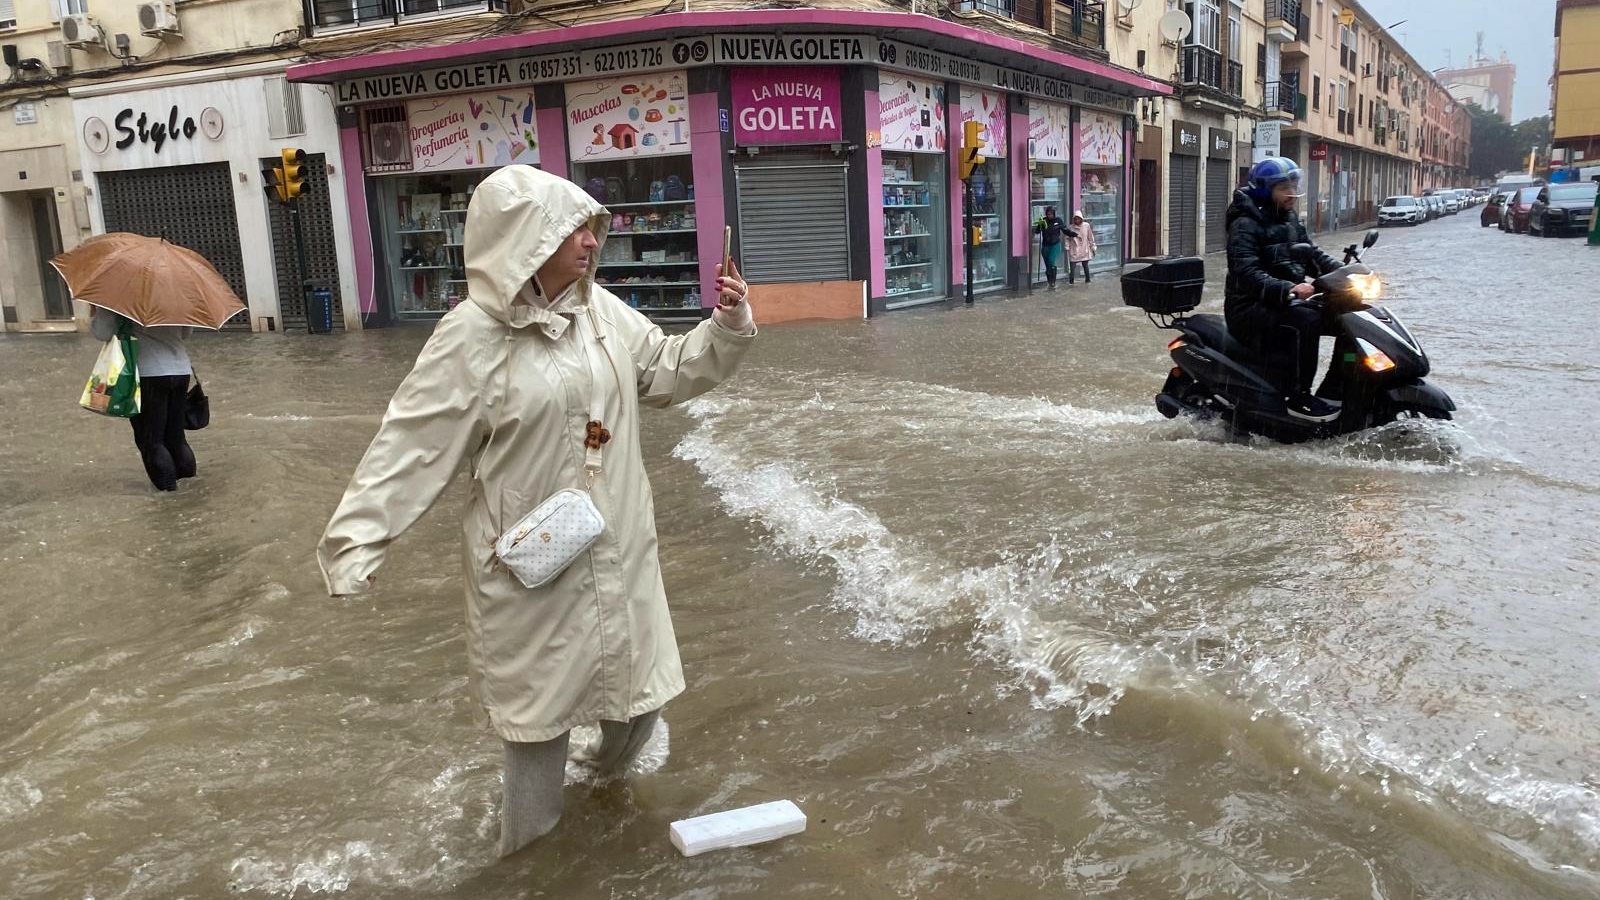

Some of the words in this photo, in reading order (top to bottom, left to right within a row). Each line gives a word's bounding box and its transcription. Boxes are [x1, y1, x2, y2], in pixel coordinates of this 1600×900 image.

[721, 38, 788, 60] NUEVA
[790, 38, 863, 60] GOLETA
[338, 82, 361, 102] LA
[365, 74, 427, 99] NUEVA
[435, 63, 512, 91] GOLETA
[519, 61, 539, 81] 619
[541, 58, 560, 78] 857
[563, 56, 582, 77] 351
[594, 52, 615, 72] 622
[617, 50, 638, 70] 013
[641, 47, 663, 68] 726
[905, 49, 918, 68] 619
[918, 52, 930, 71] 857
[930, 54, 941, 73] 351
[949, 59, 959, 76] 622
[960, 61, 970, 79] 013
[970, 63, 981, 81] 726
[996, 69, 1008, 87] LA
[1012, 72, 1041, 94] NUEVA
[1044, 80, 1073, 100] GOLETA
[752, 85, 771, 102] LA
[774, 82, 822, 101] NUEVA
[410, 110, 459, 141] Droguería
[570, 96, 621, 125] Mascotas
[739, 106, 835, 131] GOLETA
[115, 105, 197, 154] Stylo
[415, 126, 469, 158] Perfumería
